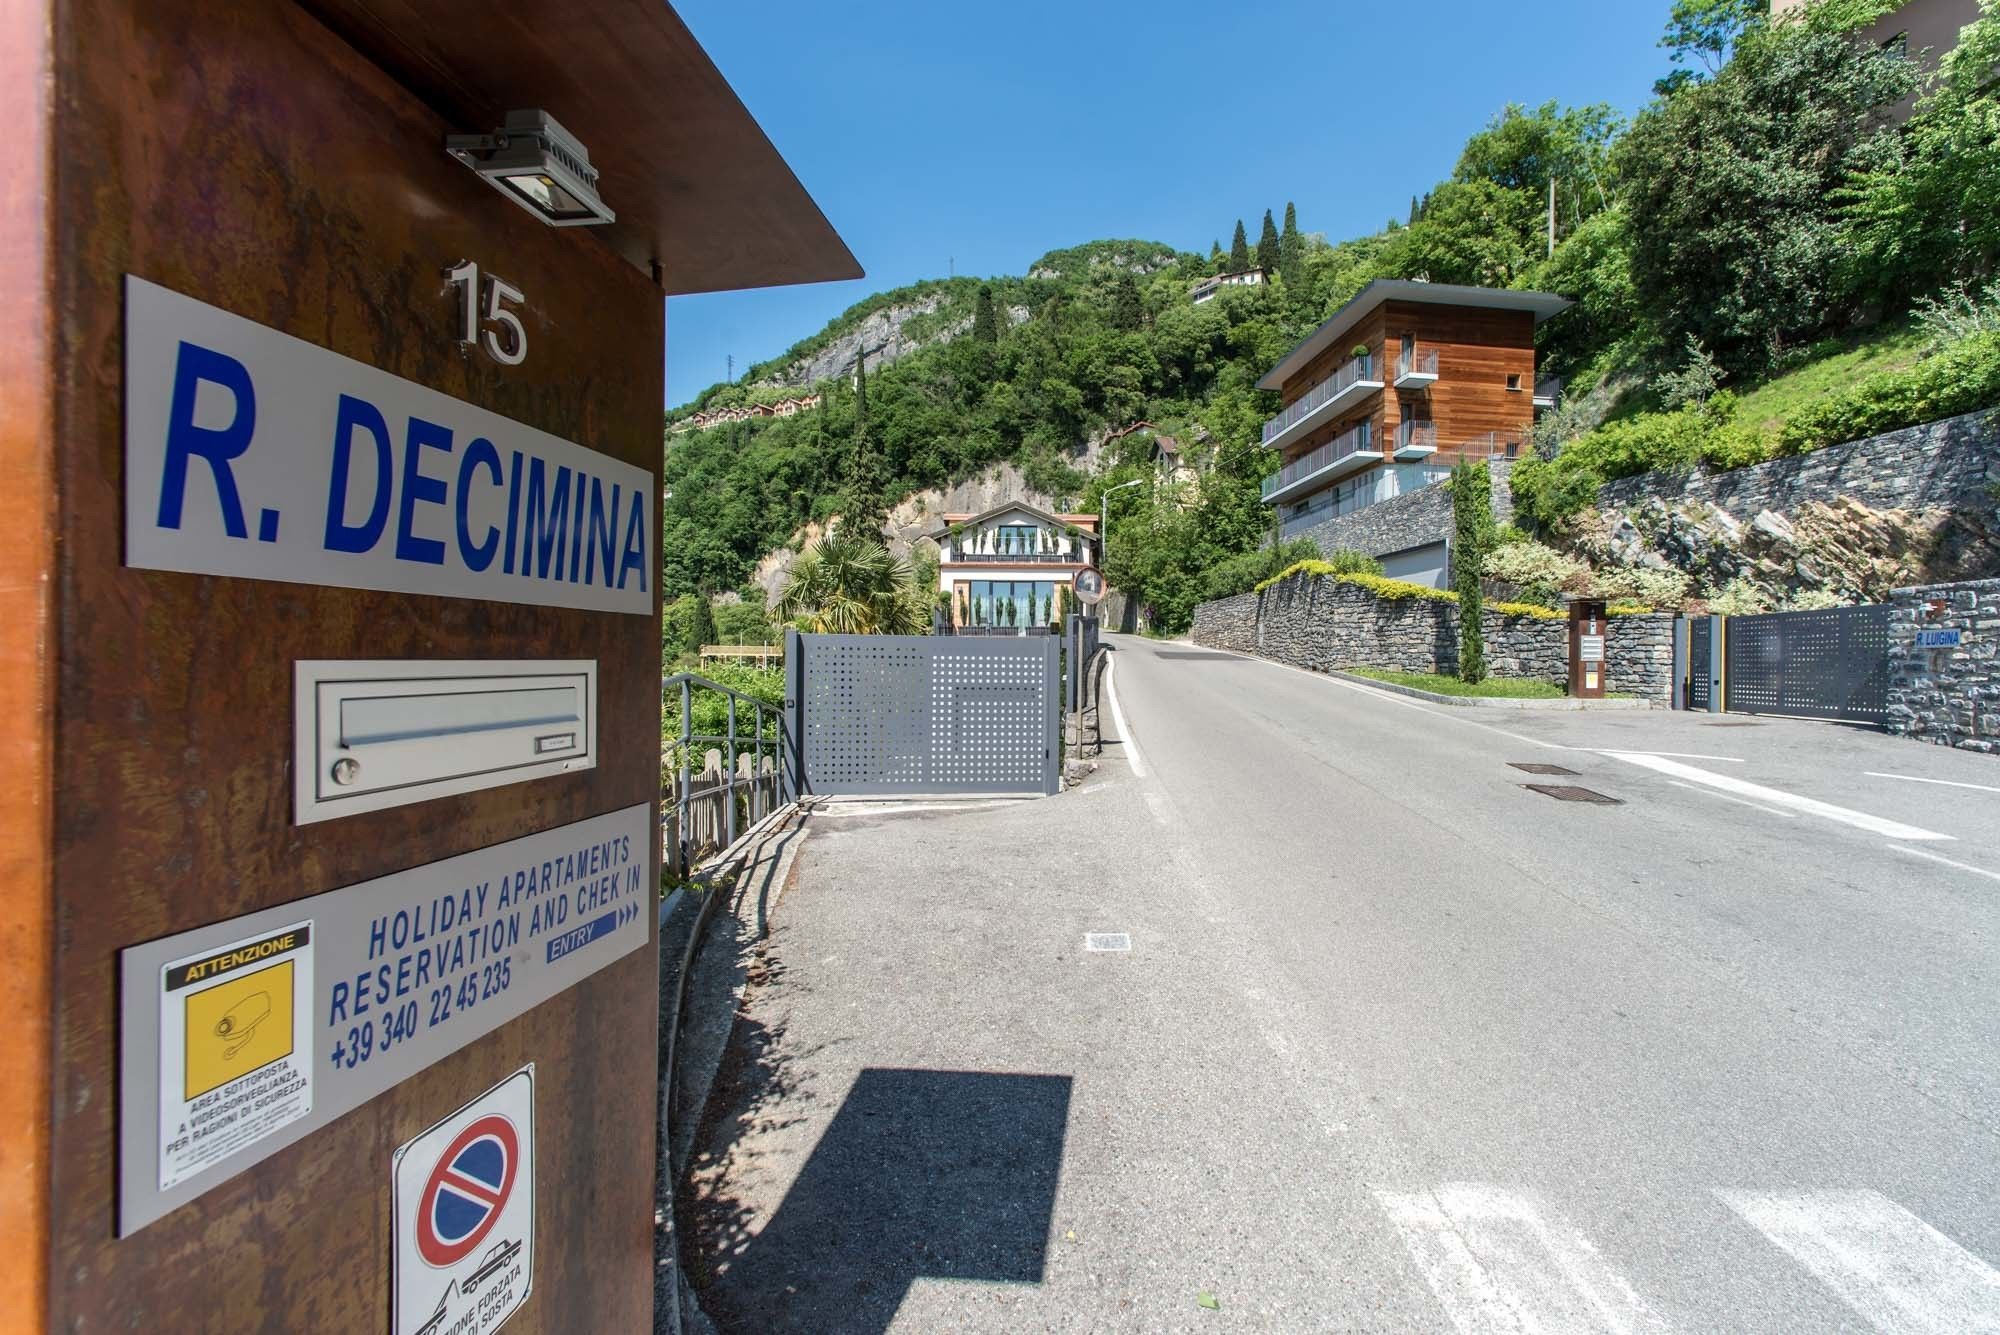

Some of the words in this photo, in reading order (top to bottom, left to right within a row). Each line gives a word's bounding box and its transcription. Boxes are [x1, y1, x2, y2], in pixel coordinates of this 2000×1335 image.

[449, 260, 528, 365] 15
[157, 340, 280, 542] R.
[323, 393, 647, 592] DECIMINA
[1926, 631, 1959, 646] LUIGINA
[369, 882, 489, 960] HOLIDAY
[497, 835, 629, 911] APARTAMENTS
[184, 934, 295, 982] ATTENZIONE
[329, 912, 520, 1027] RESERVATION
[529, 894, 568, 937] AND
[577, 872, 620, 915] CHEK
[626, 864, 641, 894] IN
[551, 923, 594, 960] ENTRY
[331, 1020, 373, 1069] +39
[380, 1000, 417, 1052] 340
[429, 984, 452, 1027] 22
[456, 972, 478, 1011] 45
[482, 956, 511, 1000] 235
[166, 1135, 189, 1155] PER
[192, 1111, 238, 1142] RAGIONI
[240, 1103, 252, 1118] DI
[254, 1077, 307, 1111] SICUREZZA
[178, 1122, 187, 1135] A
[190, 1069, 299, 1128] VIDEOSORVEGLIANZA
[190, 1092, 221, 1114] AREA
[223, 1060, 289, 1098] SOTTOPOSTA
[478, 1263, 521, 1315] FORZATA
[481, 1289, 513, 1329] SOSTA
